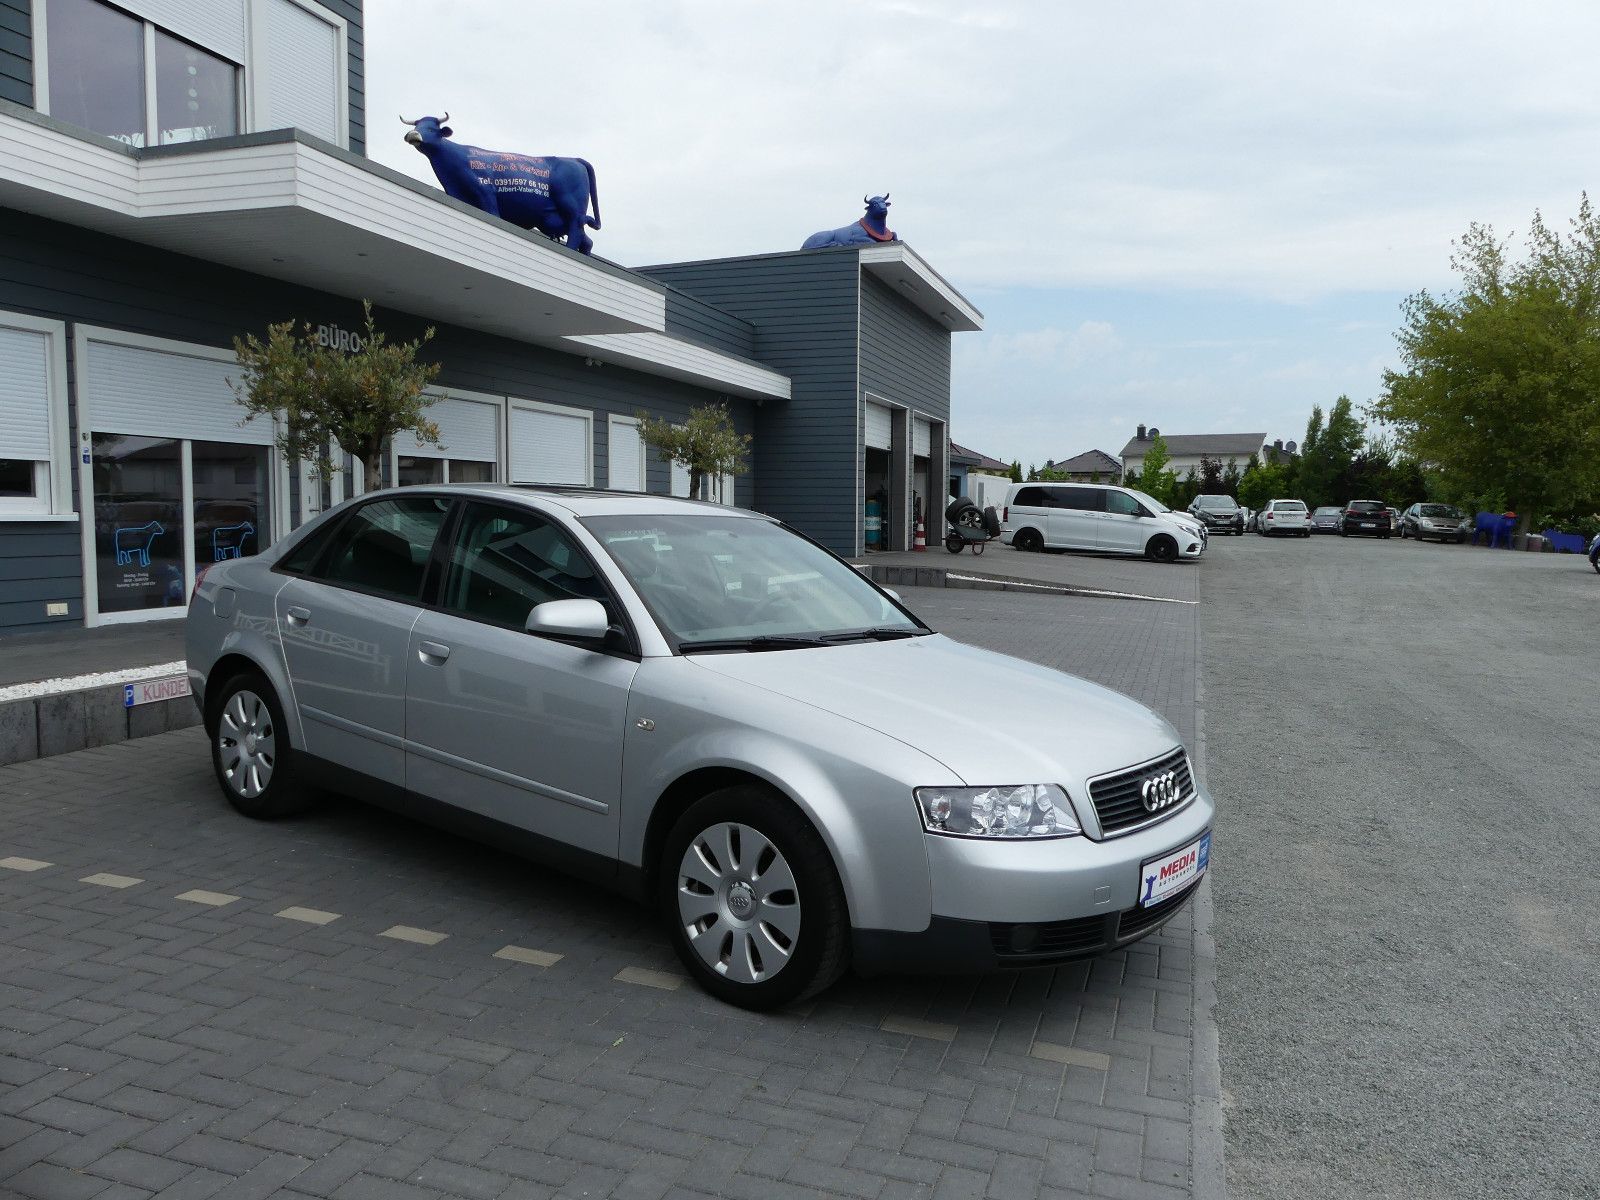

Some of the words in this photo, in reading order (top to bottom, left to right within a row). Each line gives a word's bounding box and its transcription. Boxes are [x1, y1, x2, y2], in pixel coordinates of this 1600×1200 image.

[479, 177, 493, 185] Tel.
[494, 178, 527, 186] 0391/597
[538, 182, 549, 191] 100
[319, 323, 360, 353] BÜRO
[125, 689, 133, 702] P
[143, 679, 191, 701] KUNDE
[1160, 850, 1196, 880] MEDIA
